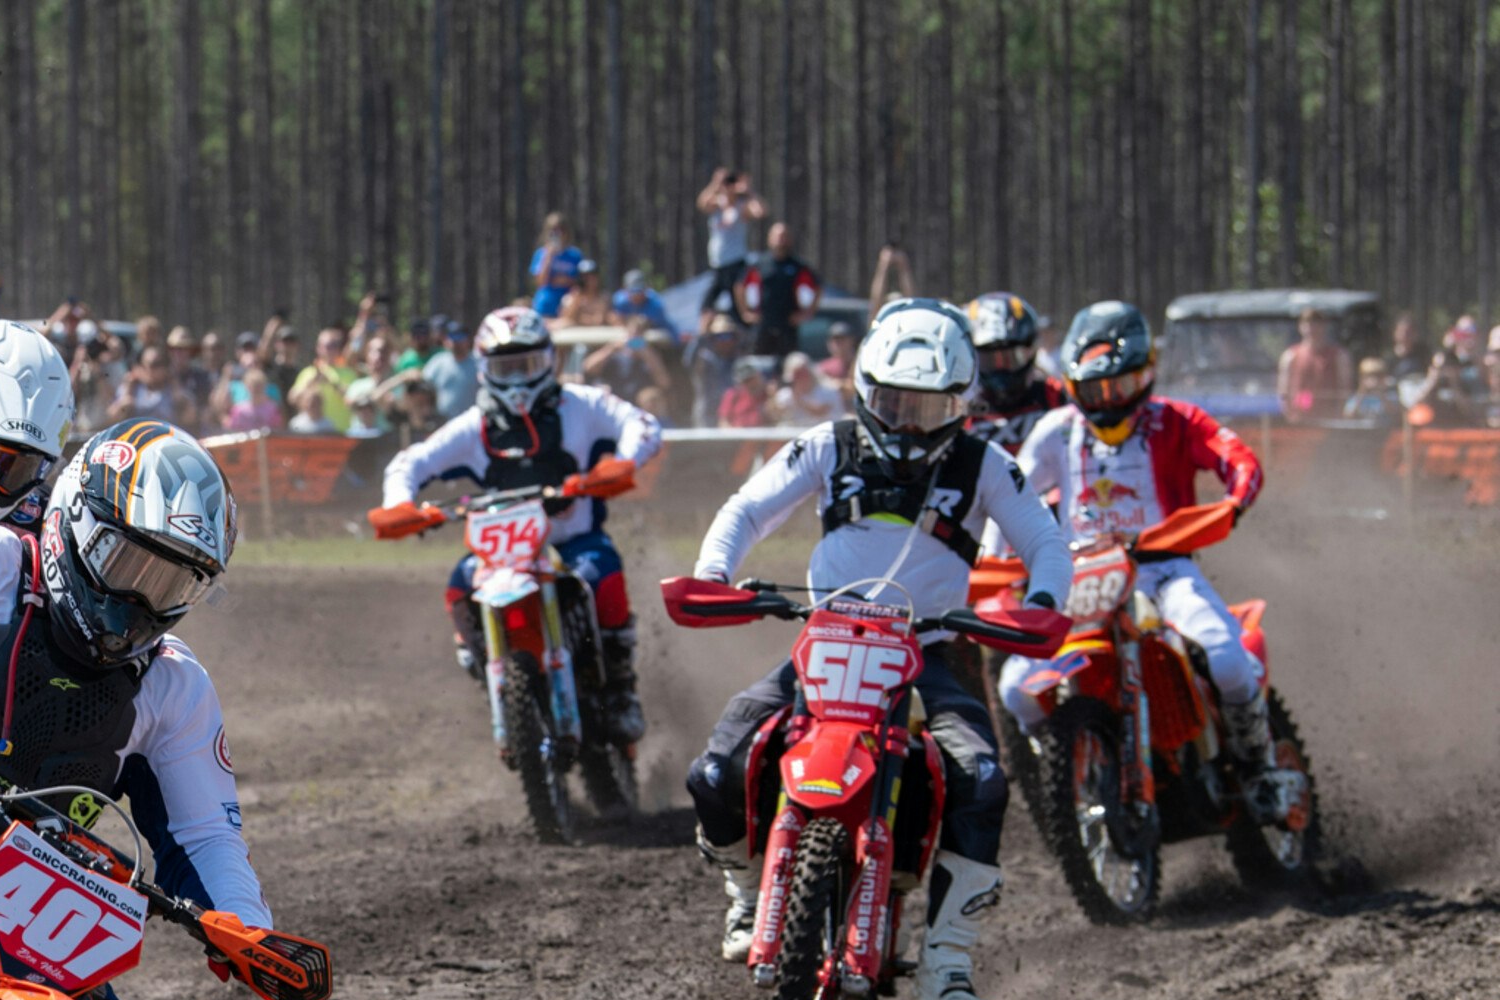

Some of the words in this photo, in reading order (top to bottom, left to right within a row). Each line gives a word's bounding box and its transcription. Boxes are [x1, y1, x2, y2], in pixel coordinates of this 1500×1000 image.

[7, 420, 42, 440] SHOEI
[480, 517, 539, 556] 514
[43, 547, 66, 595] 407
[804, 641, 907, 709] 515
[32, 847, 143, 921] GNCCRACING.COM
[240, 947, 303, 983] ACERBIS
